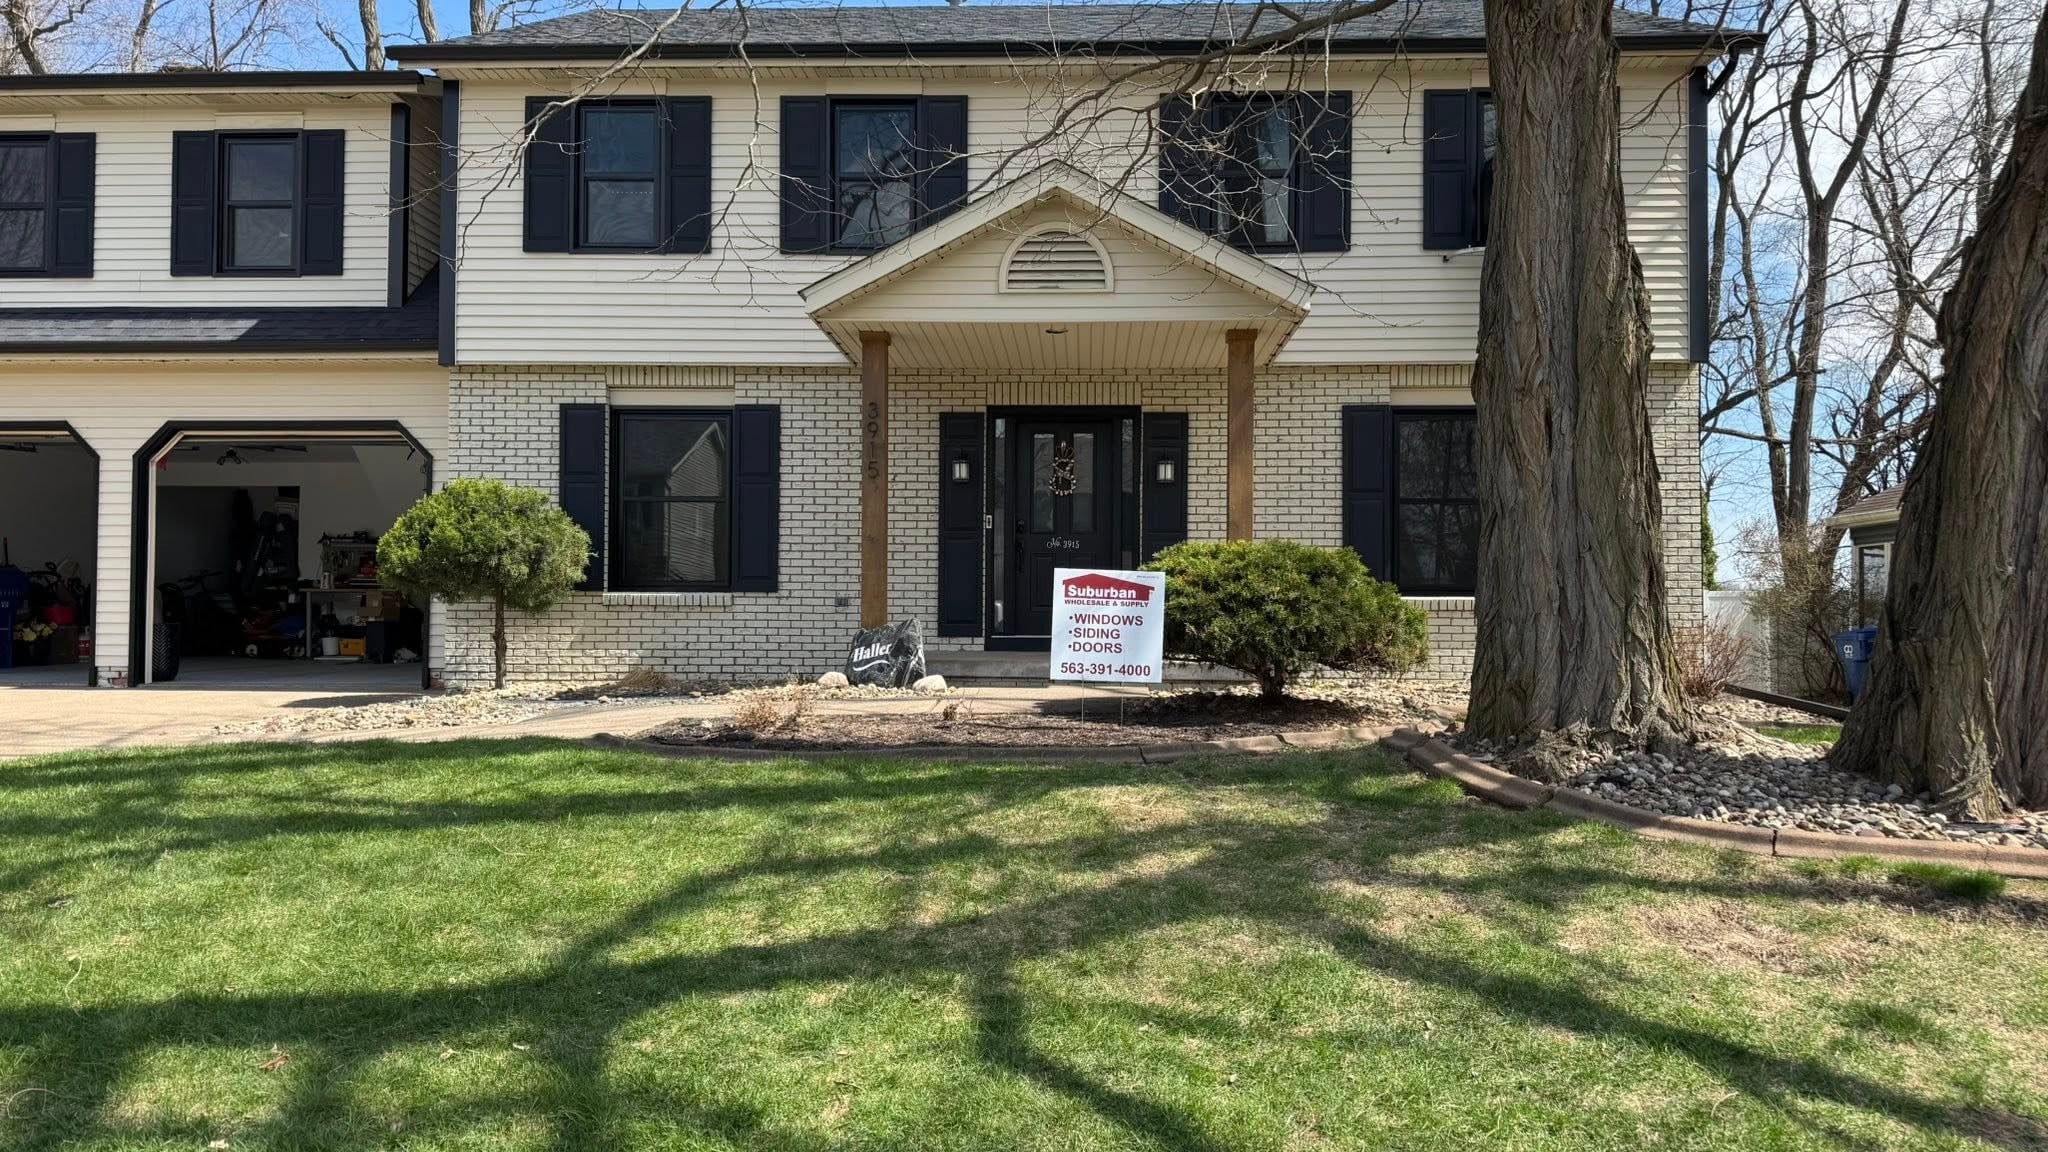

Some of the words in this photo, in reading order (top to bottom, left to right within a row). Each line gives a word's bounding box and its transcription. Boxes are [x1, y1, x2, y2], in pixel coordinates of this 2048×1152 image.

[867, 402, 879, 479] 3915
[1063, 540, 1080, 549] 3915
[1068, 584, 1136, 599] Suburban
[1064, 599, 1110, 607] WHOLESALE
[1074, 613, 1144, 626] WINDOWS
[1073, 627, 1121, 640] SIDING
[853, 642, 893, 662] Haller
[1072, 641, 1123, 654] DOORS
[1060, 662, 1151, 677] 563-391-4000
